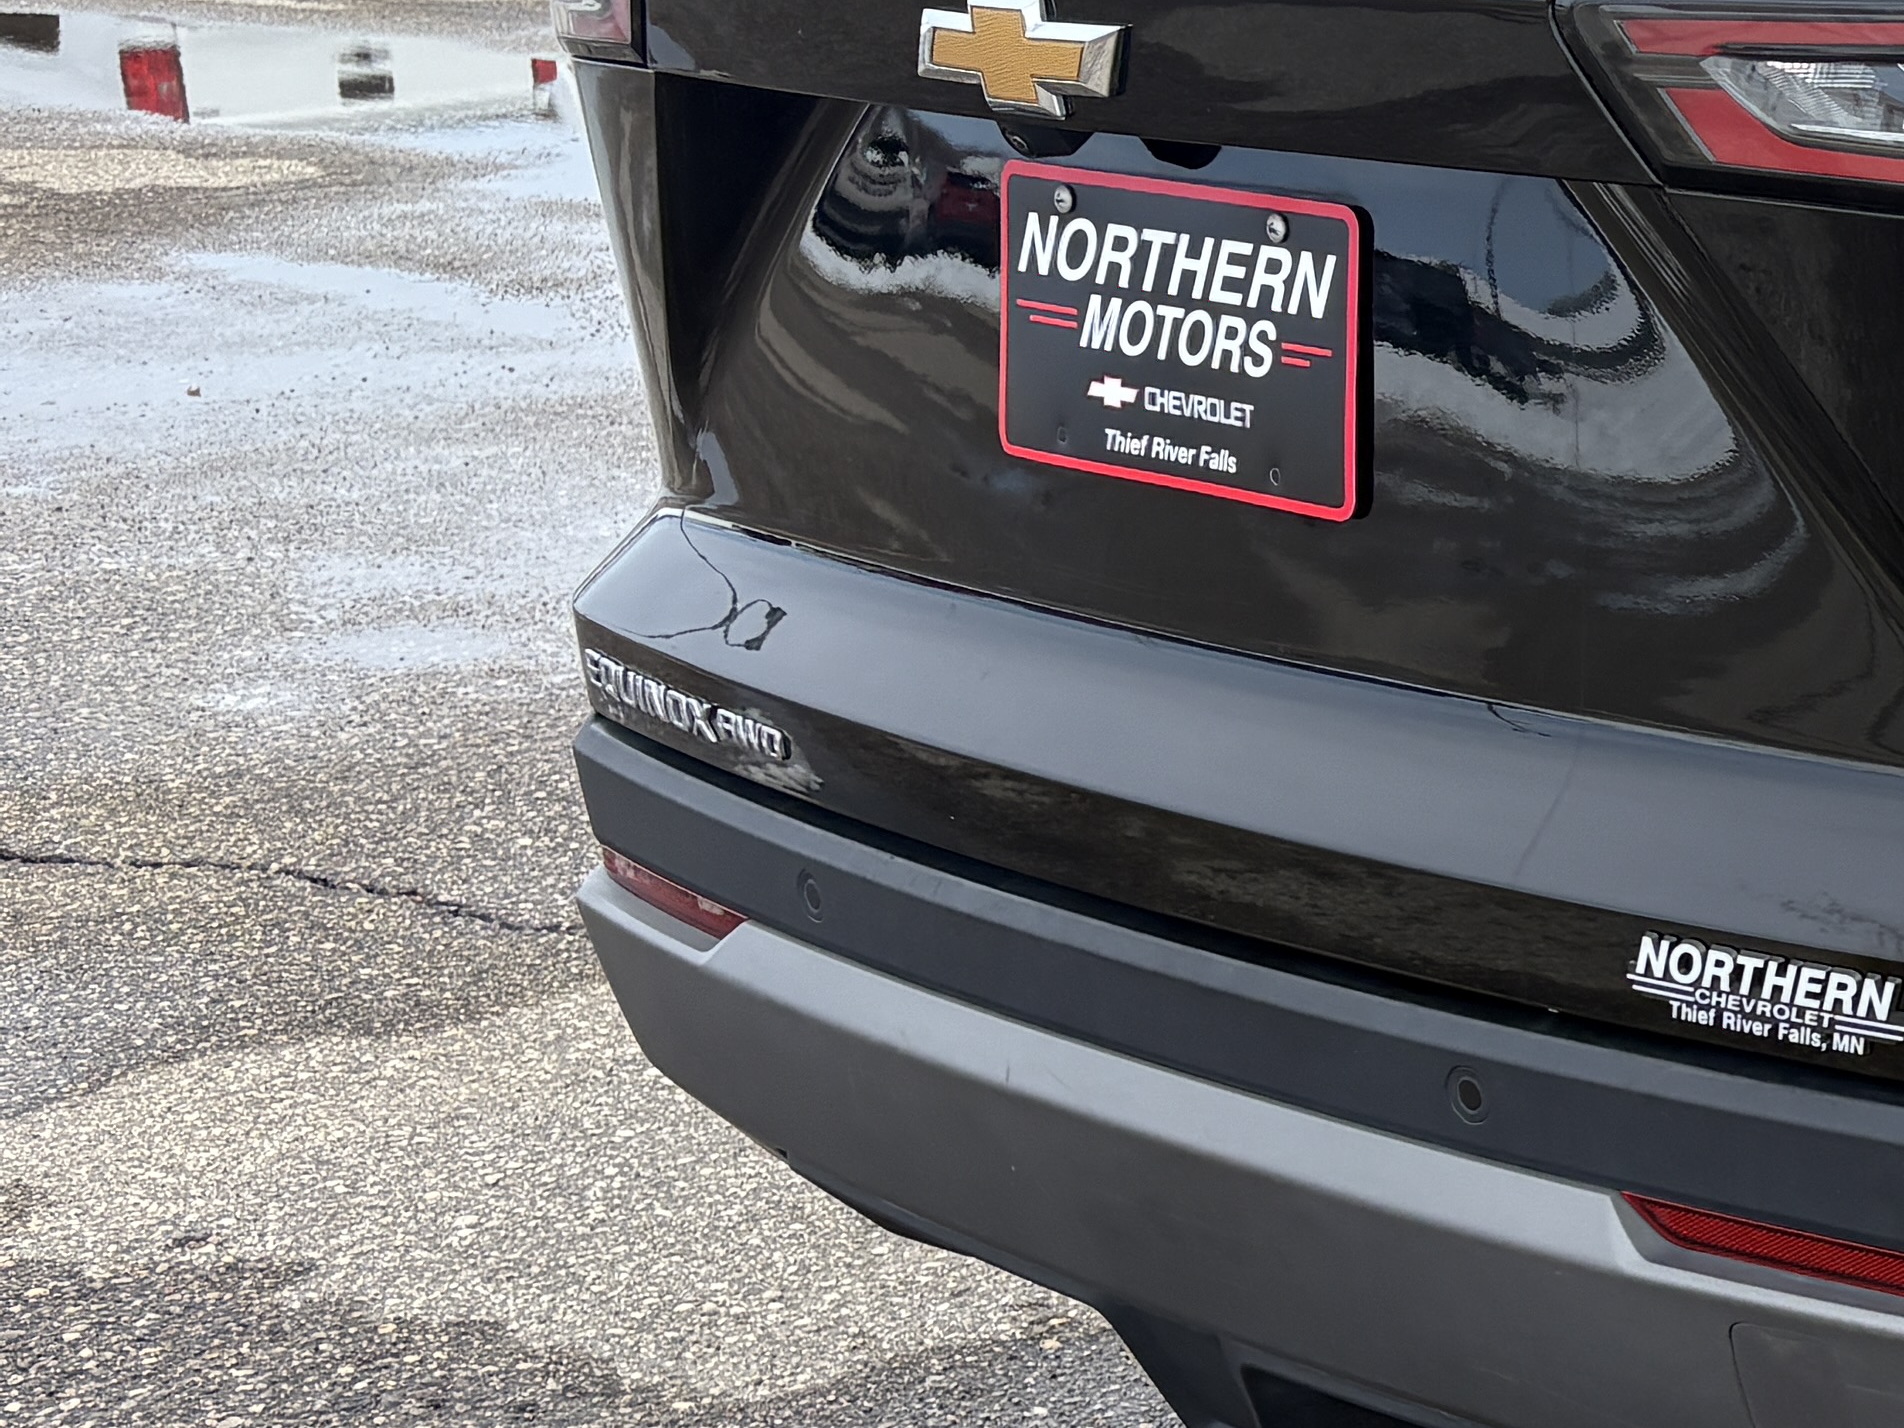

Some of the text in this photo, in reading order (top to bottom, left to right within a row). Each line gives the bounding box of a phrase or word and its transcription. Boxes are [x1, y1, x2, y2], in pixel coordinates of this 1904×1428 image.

[1018, 210, 1337, 320] NORTHERN
[1078, 293, 1277, 379] MOTORS
[1143, 386, 1254, 430] CHEVROLET
[1104, 428, 1237, 475] Thief River Falls
[1635, 932, 1900, 1022] NORTHERN
[1669, 1000, 1865, 1056] Thief River Falls, MN
[1694, 988, 1835, 1028] CHEVROLET
